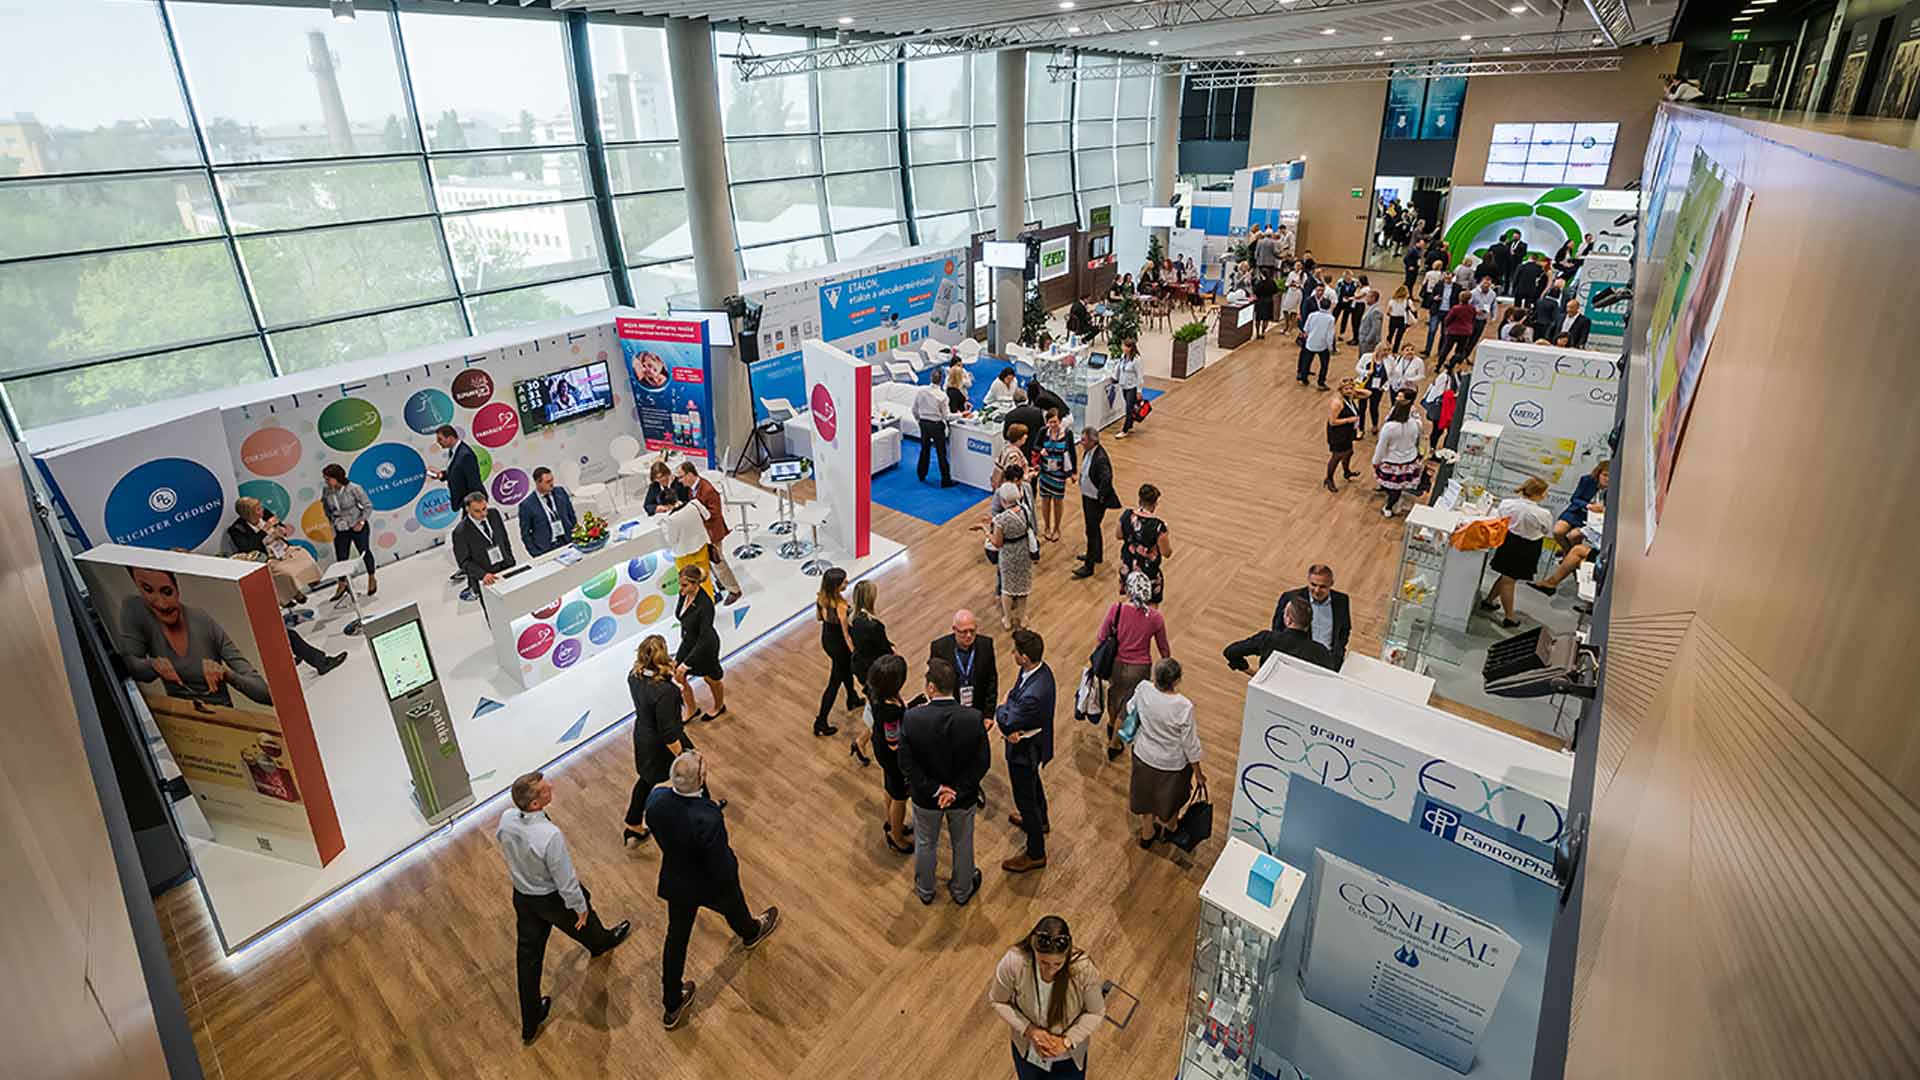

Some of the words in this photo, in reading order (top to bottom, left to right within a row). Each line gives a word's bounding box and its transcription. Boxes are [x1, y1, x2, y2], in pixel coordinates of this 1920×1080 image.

[1514, 408, 1544, 421] MERZ
[116, 519, 172, 545] RICHTER
[173, 497, 222, 523] GEDEON
[1309, 724, 1356, 749] grand
